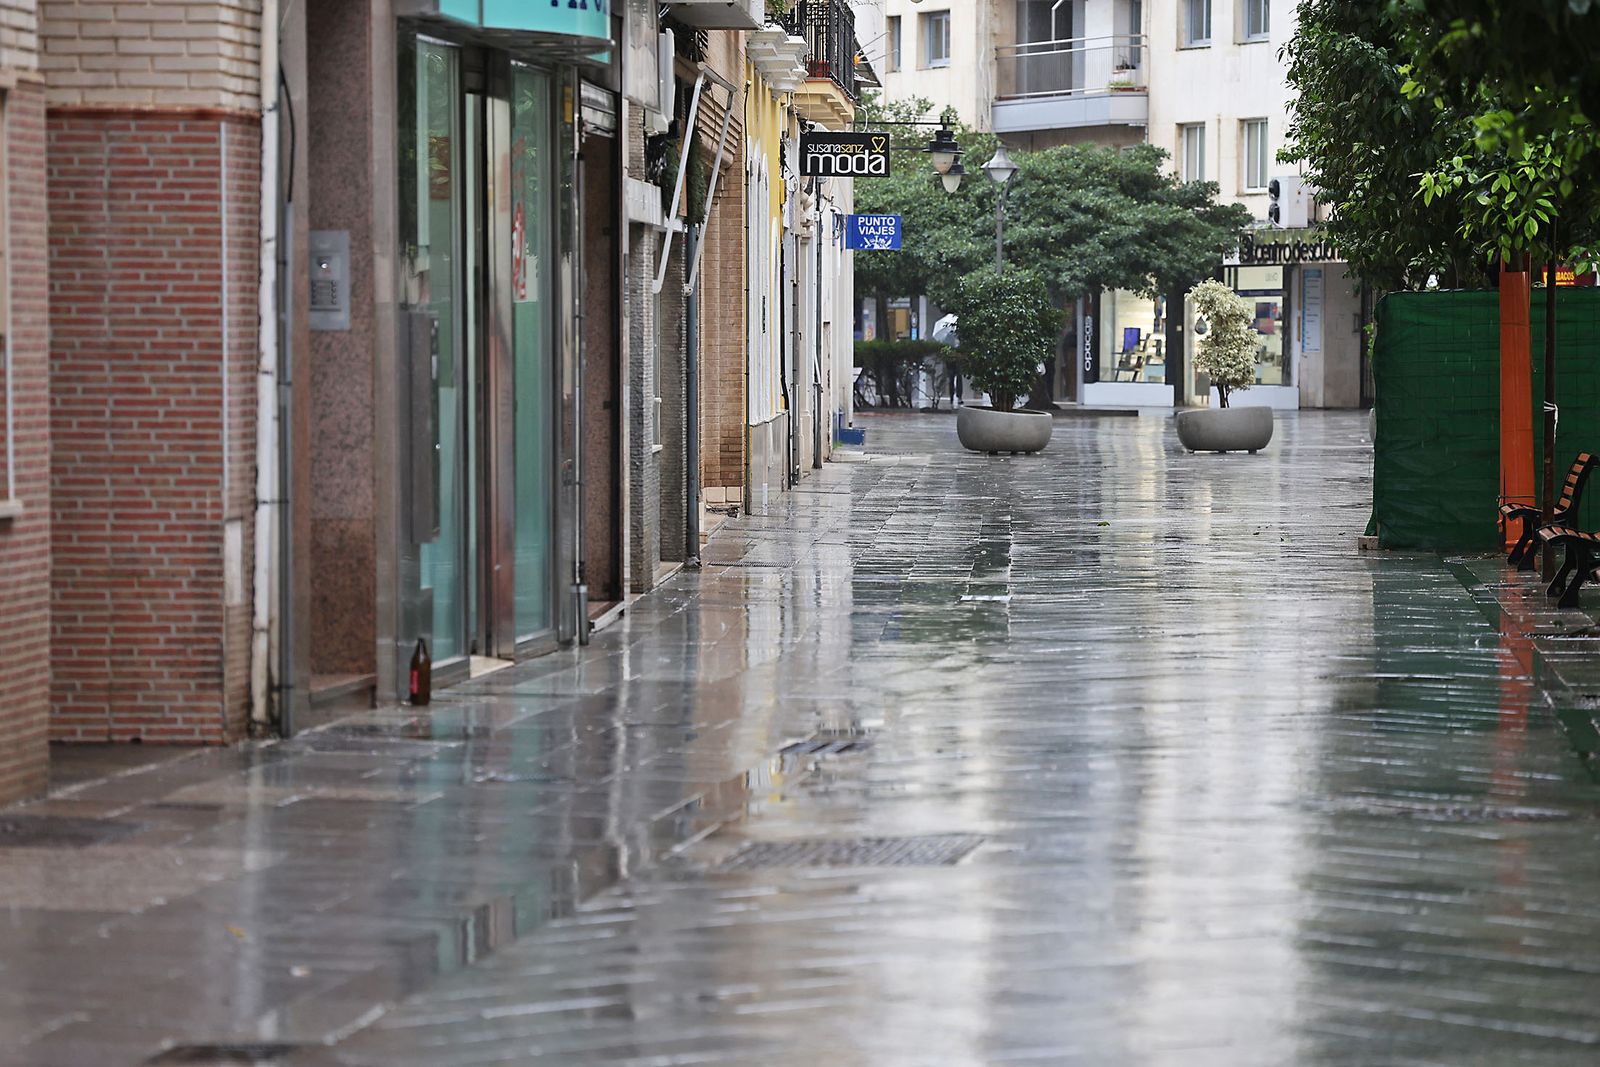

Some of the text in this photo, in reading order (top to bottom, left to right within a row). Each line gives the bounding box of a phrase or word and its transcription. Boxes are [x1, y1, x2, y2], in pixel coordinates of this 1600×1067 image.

[807, 149, 885, 174] moda
[858, 216, 896, 226] PUNTO
[858, 226, 896, 235] VIAJES
